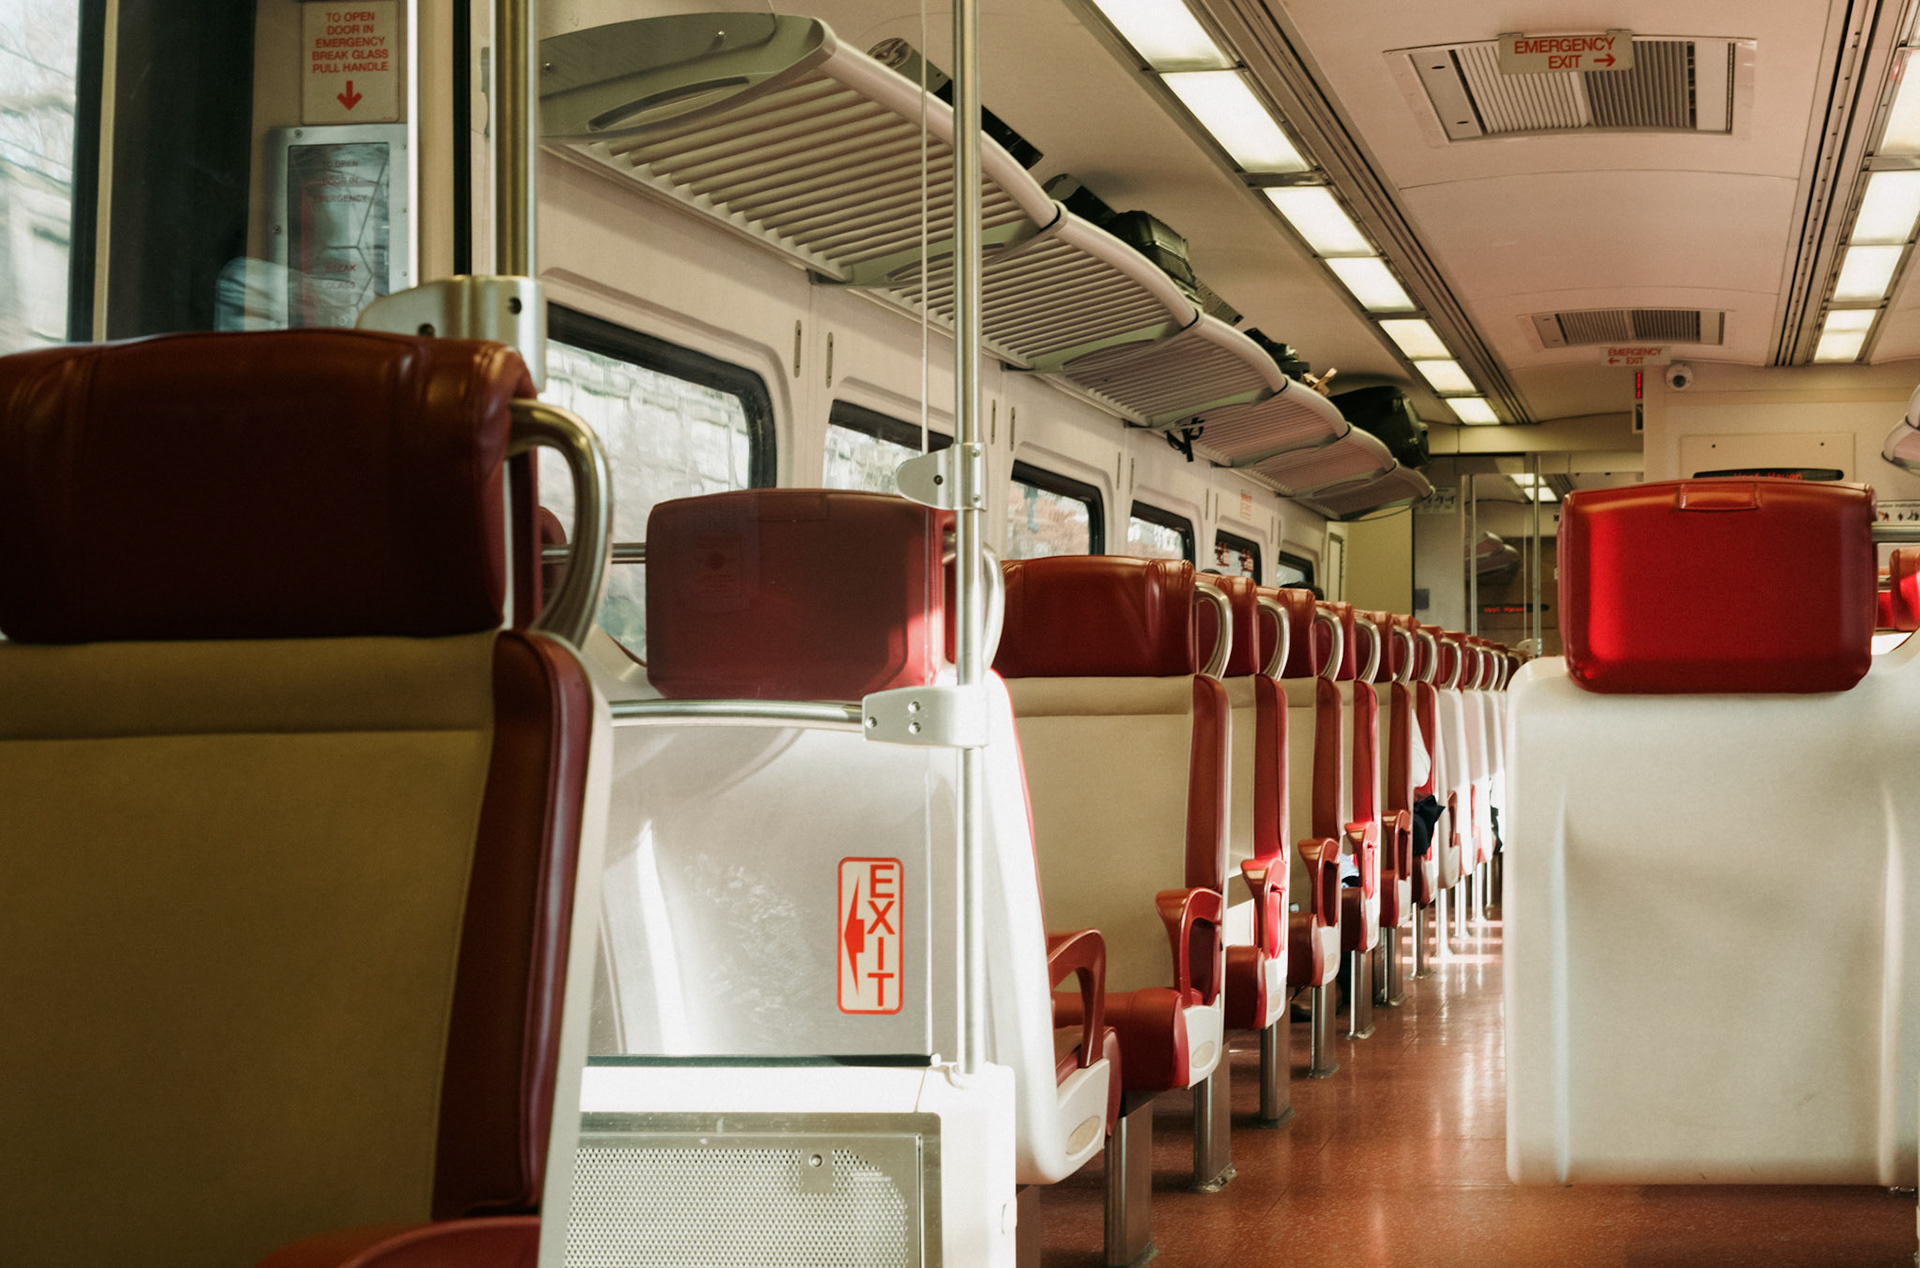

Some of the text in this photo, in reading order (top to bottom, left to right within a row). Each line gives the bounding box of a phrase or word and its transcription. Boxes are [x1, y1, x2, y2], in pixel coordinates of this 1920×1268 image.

[326, 12, 375, 23] TO OPEN
[327, 25, 374, 36] DOOR IN
[315, 37, 385, 48] EMERGENCY
[1514, 37, 1616, 54] EMERGENCY
[312, 49, 389, 61] BREAK GLASS
[312, 62, 388, 73] PULL HANDLE
[1548, 55, 1582, 69] EXIT
[1608, 348, 1662, 356] EMERGENCY
[1626, 357, 1643, 365] EXIT
[866, 864, 896, 1007] EXIT
